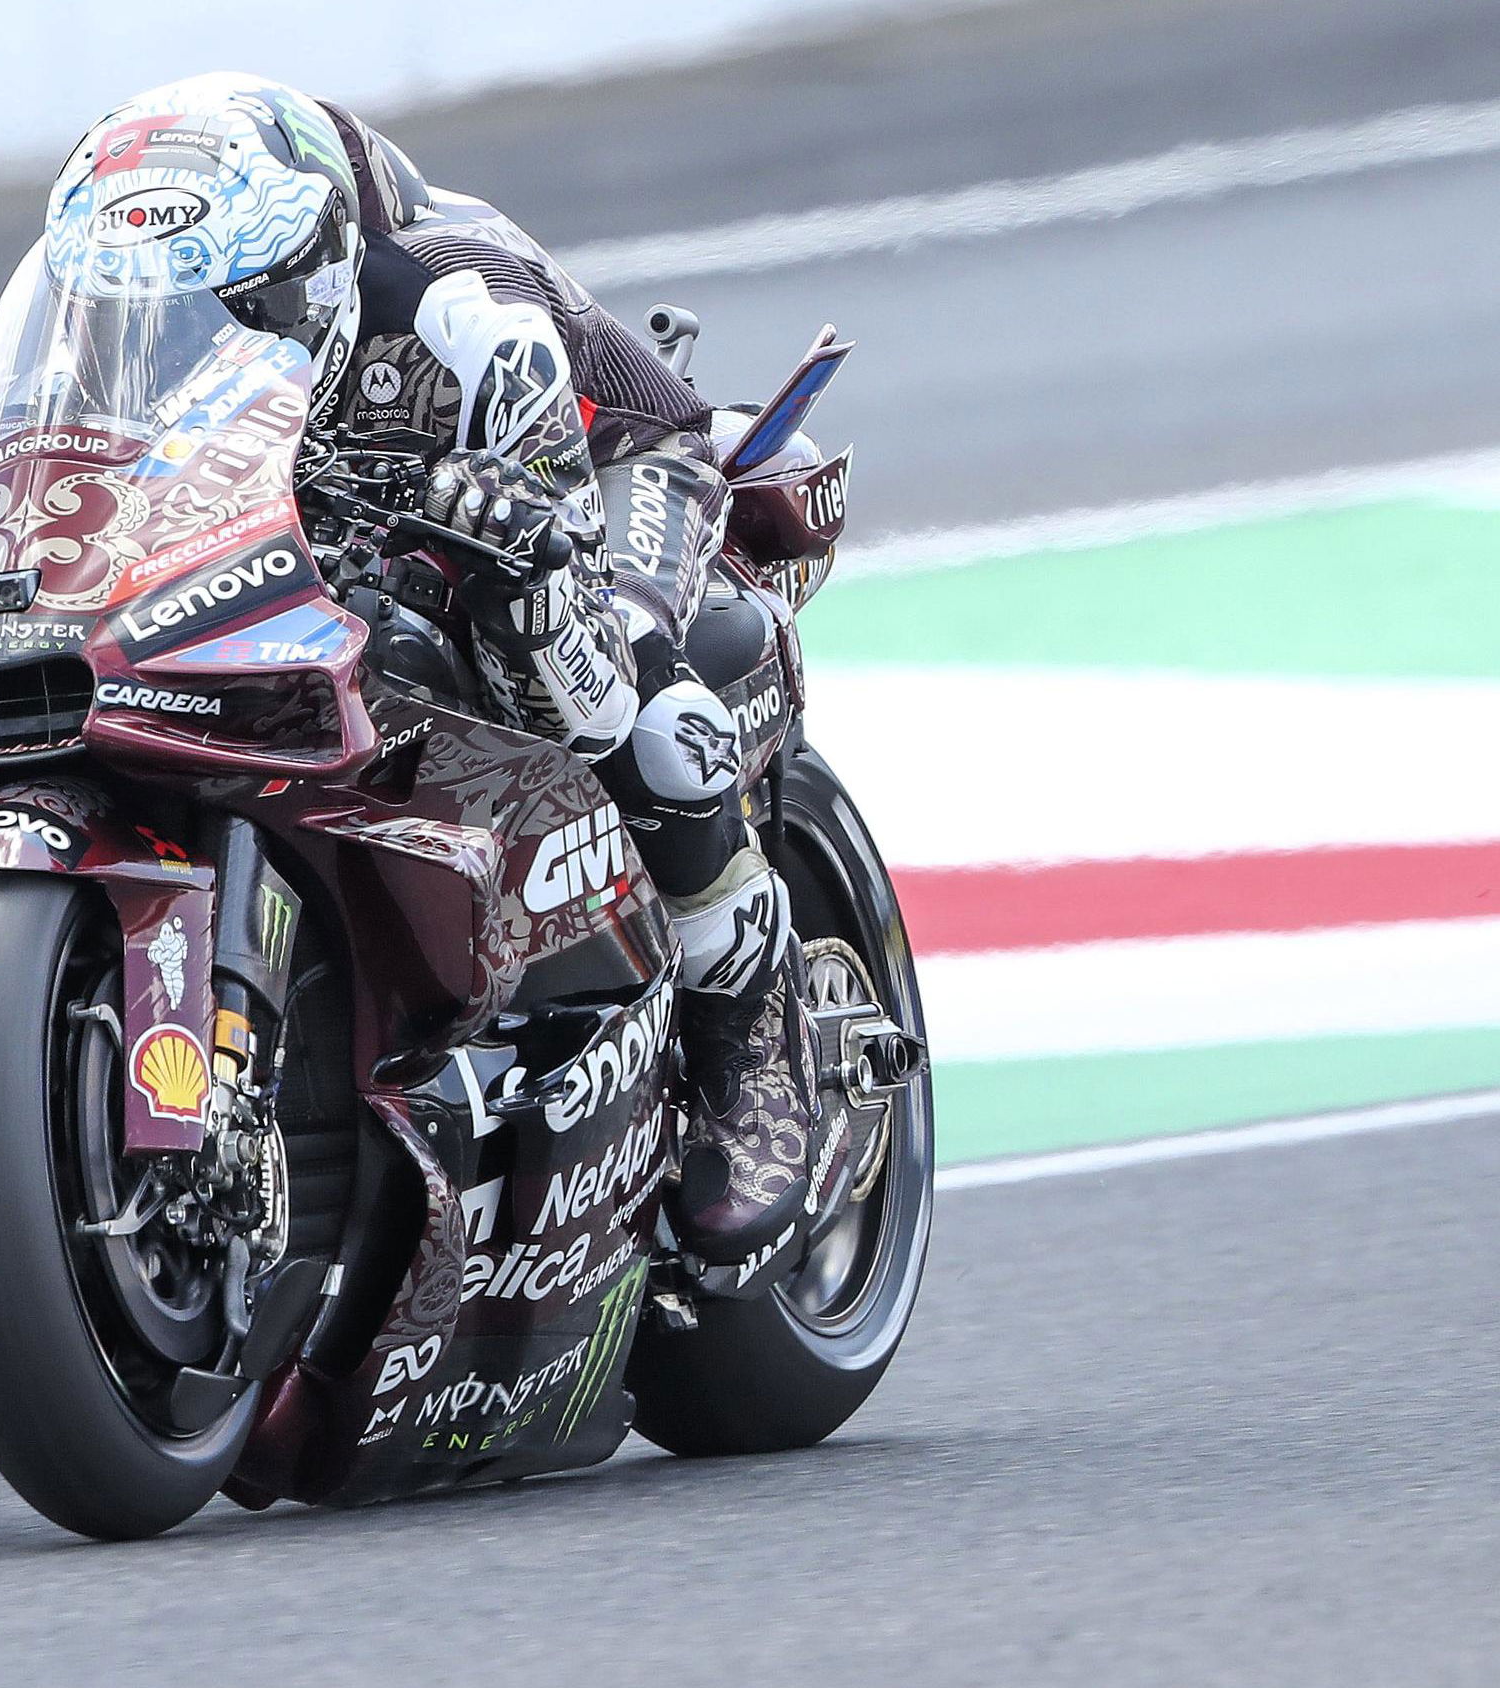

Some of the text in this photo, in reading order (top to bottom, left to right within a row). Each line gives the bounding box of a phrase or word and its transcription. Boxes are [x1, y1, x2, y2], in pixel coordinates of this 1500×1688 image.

[150, 131, 217, 147] Lenovo
[98, 205, 198, 232] SUOMY
[218, 272, 270, 298] CARRERA
[211, 322, 237, 347] PECCO
[311, 341, 345, 402] novo
[199, 395, 305, 488] riello
[357, 406, 410, 422] motorola
[130, 502, 292, 582] FRECCIAROSSA
[610, 463, 669, 577] Lenovo
[119, 549, 297, 642] Lenovo
[258, 641, 325, 662] TIM
[557, 631, 617, 710] Unipol
[96, 683, 222, 716] CARRERA
[730, 685, 781, 738] novo
[381, 715, 434, 759] port
[522, 801, 627, 914] GIVI
[529, 1101, 663, 1235] NetApp
[459, 1232, 591, 1304] elica
[568, 1232, 640, 1306] SIEMENS
[415, 1336, 590, 1427] MONSTER
[422, 1398, 553, 1451] ENERGY
